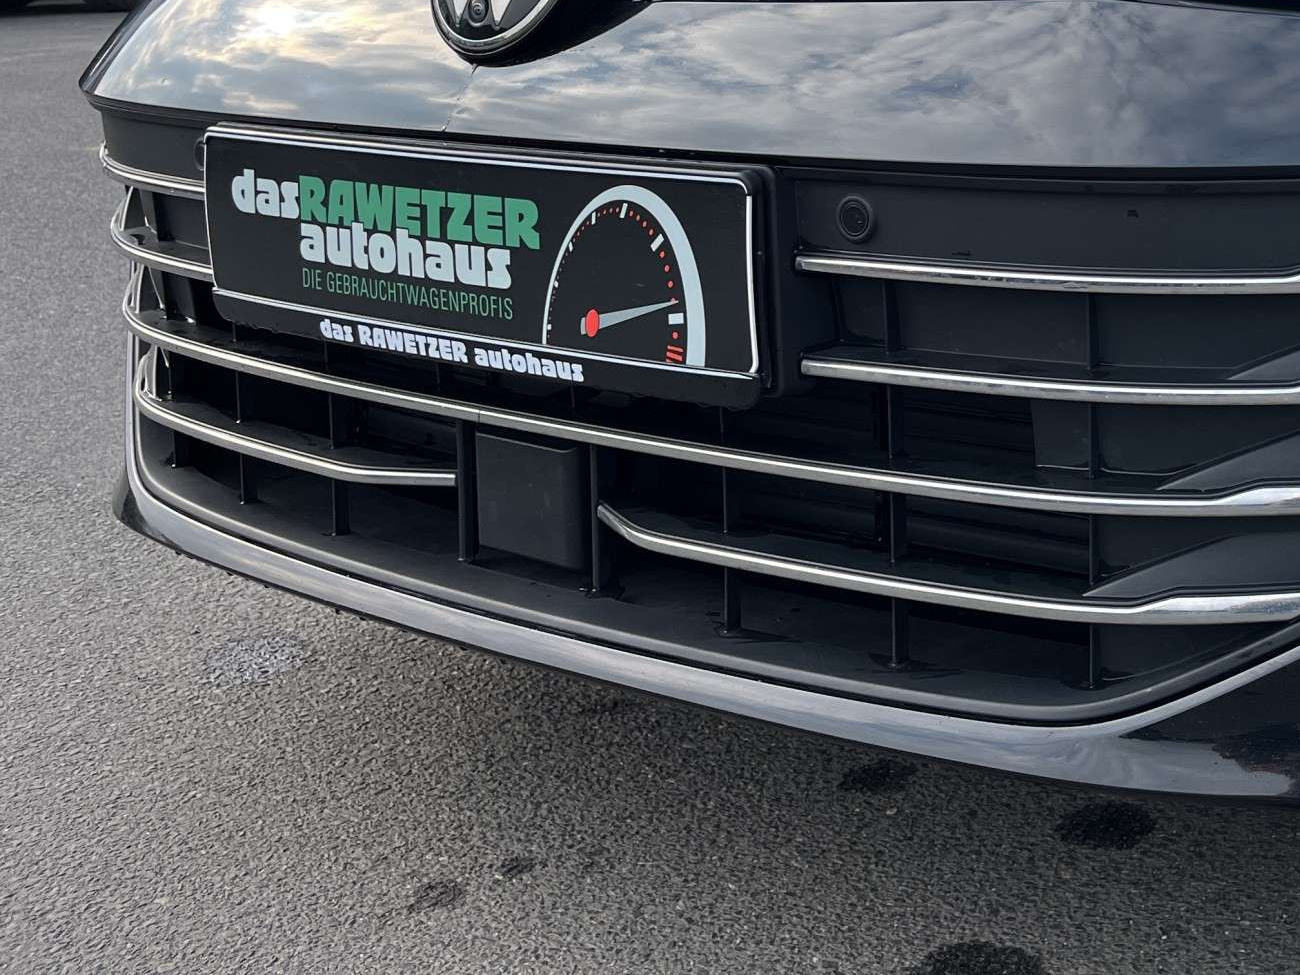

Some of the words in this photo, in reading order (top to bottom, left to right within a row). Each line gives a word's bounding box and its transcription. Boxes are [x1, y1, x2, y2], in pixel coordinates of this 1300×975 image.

[300, 221, 512, 290] autohaus
[302, 268, 322, 290] DIE
[326, 271, 513, 320] GEBRAUCHTWAGENPROFIS
[319, 318, 353, 343] das
[357, 324, 468, 363] RAWETZER
[474, 346, 584, 382] autohaus
